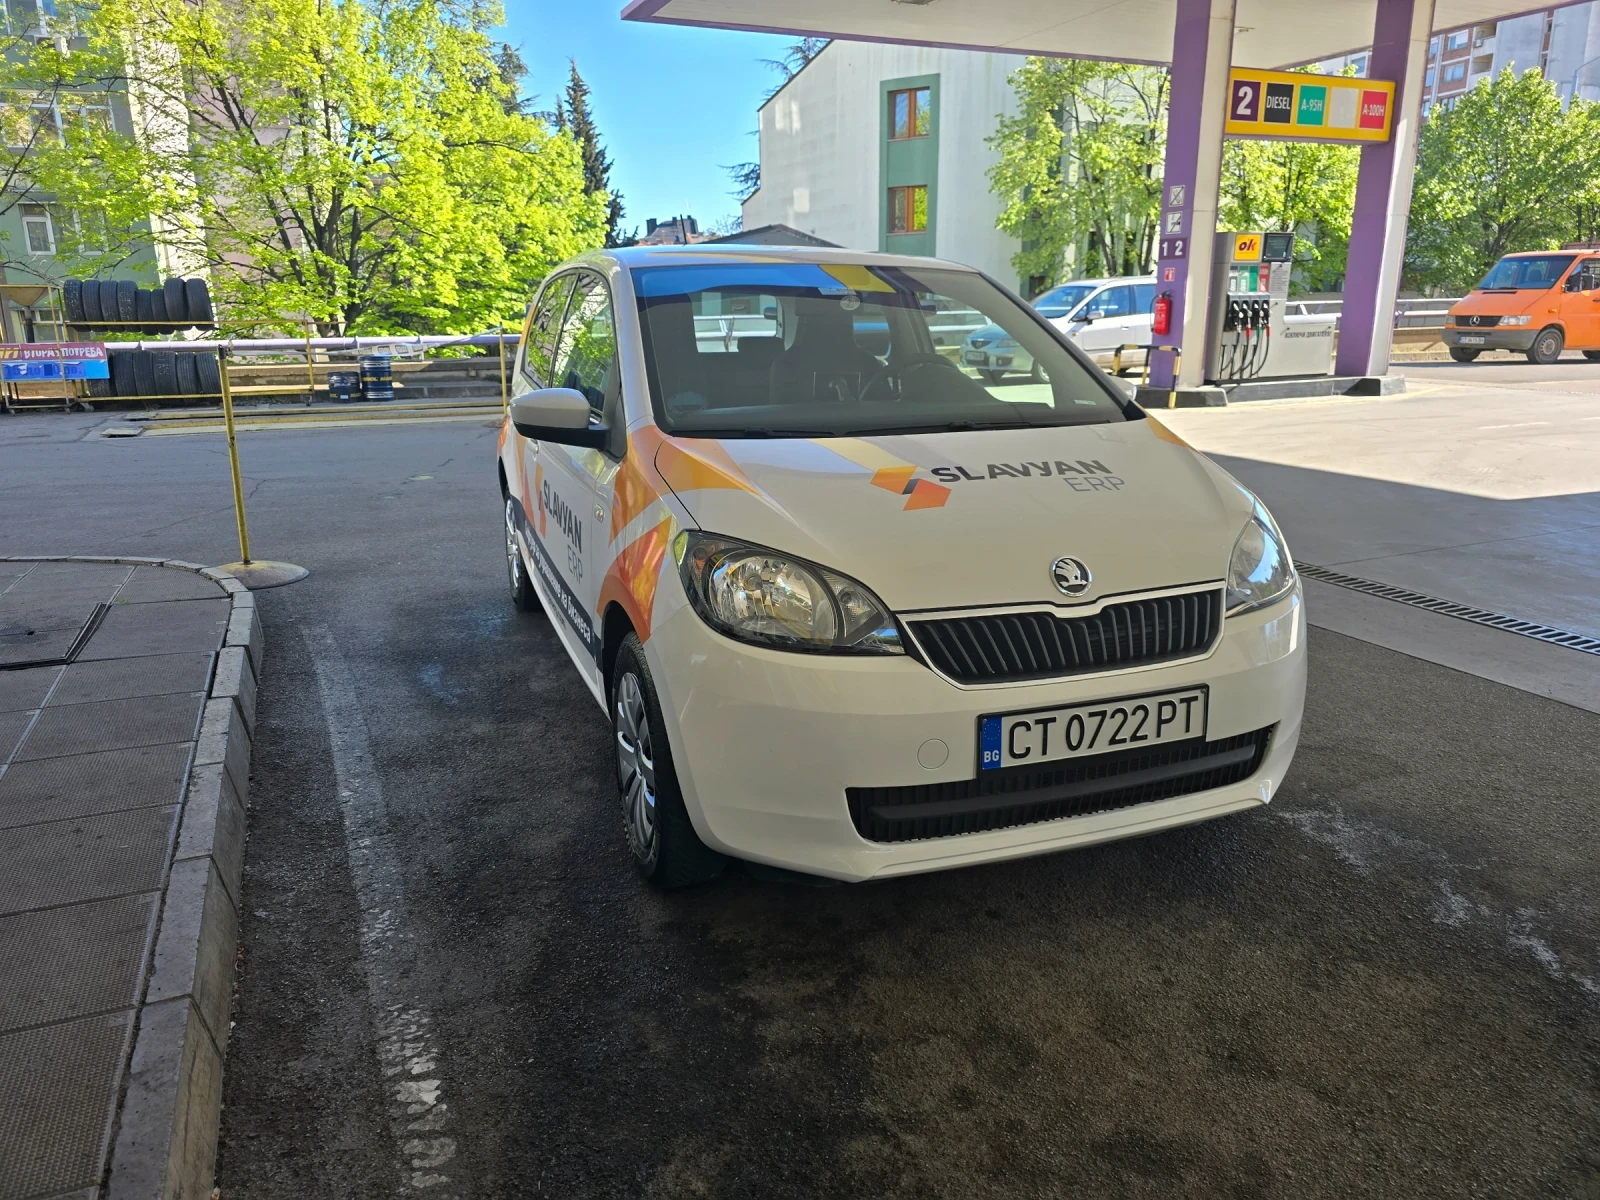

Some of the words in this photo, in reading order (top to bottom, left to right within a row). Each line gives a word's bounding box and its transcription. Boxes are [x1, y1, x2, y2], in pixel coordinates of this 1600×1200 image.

[1236, 86, 1253, 115] 2
[1266, 95, 1291, 110] DIESEL
[1301, 99, 1323, 112] A-95H
[1362, 104, 1385, 117] A-100H
[1162, 241, 1168, 256] 1
[1174, 240, 1183, 256] 2
[930, 459, 1113, 483] SLAVYAN
[1062, 476, 1125, 492] ERP
[543, 479, 582, 554] SLAVYAN
[567, 543, 584, 585] ERP
[567, 595, 591, 644] бизнеса
[1008, 716, 1057, 760] CT
[1065, 704, 1150, 752] 0722
[1156, 695, 1199, 739] PT
[983, 749, 1000, 763] BG
